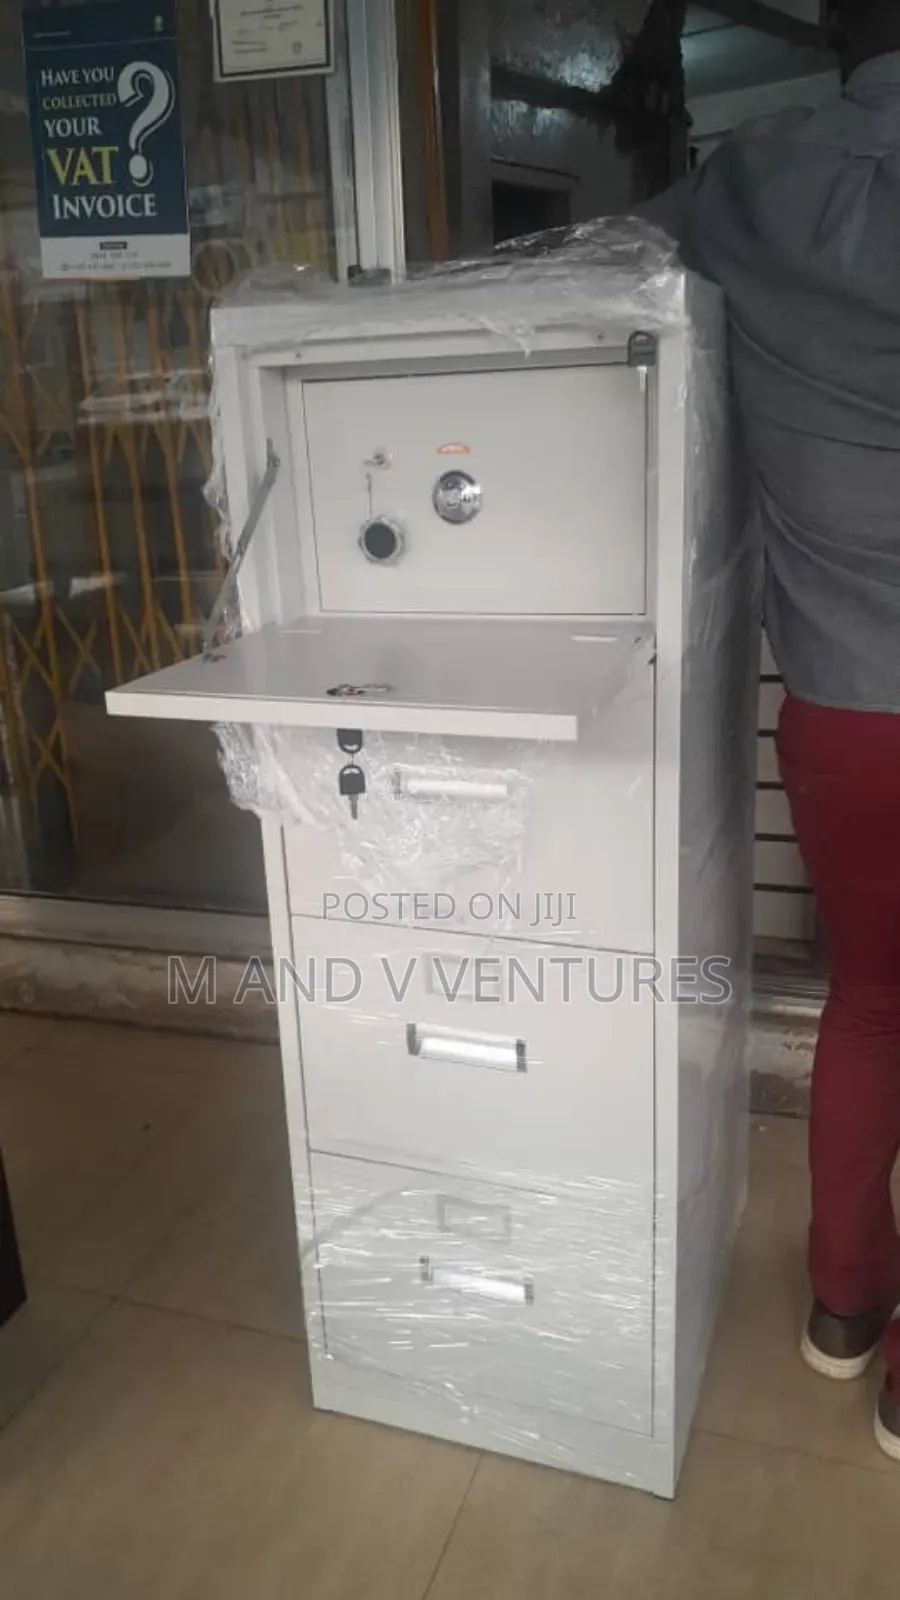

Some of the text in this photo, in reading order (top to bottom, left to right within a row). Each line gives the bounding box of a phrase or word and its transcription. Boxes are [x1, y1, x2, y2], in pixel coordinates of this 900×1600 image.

[41, 66, 115, 86] HAVE YOU
[42, 92, 117, 109] COLLECTED
[44, 116, 102, 138] YOUR
[47, 146, 119, 186] VAT
[52, 193, 157, 220] INVOICE
